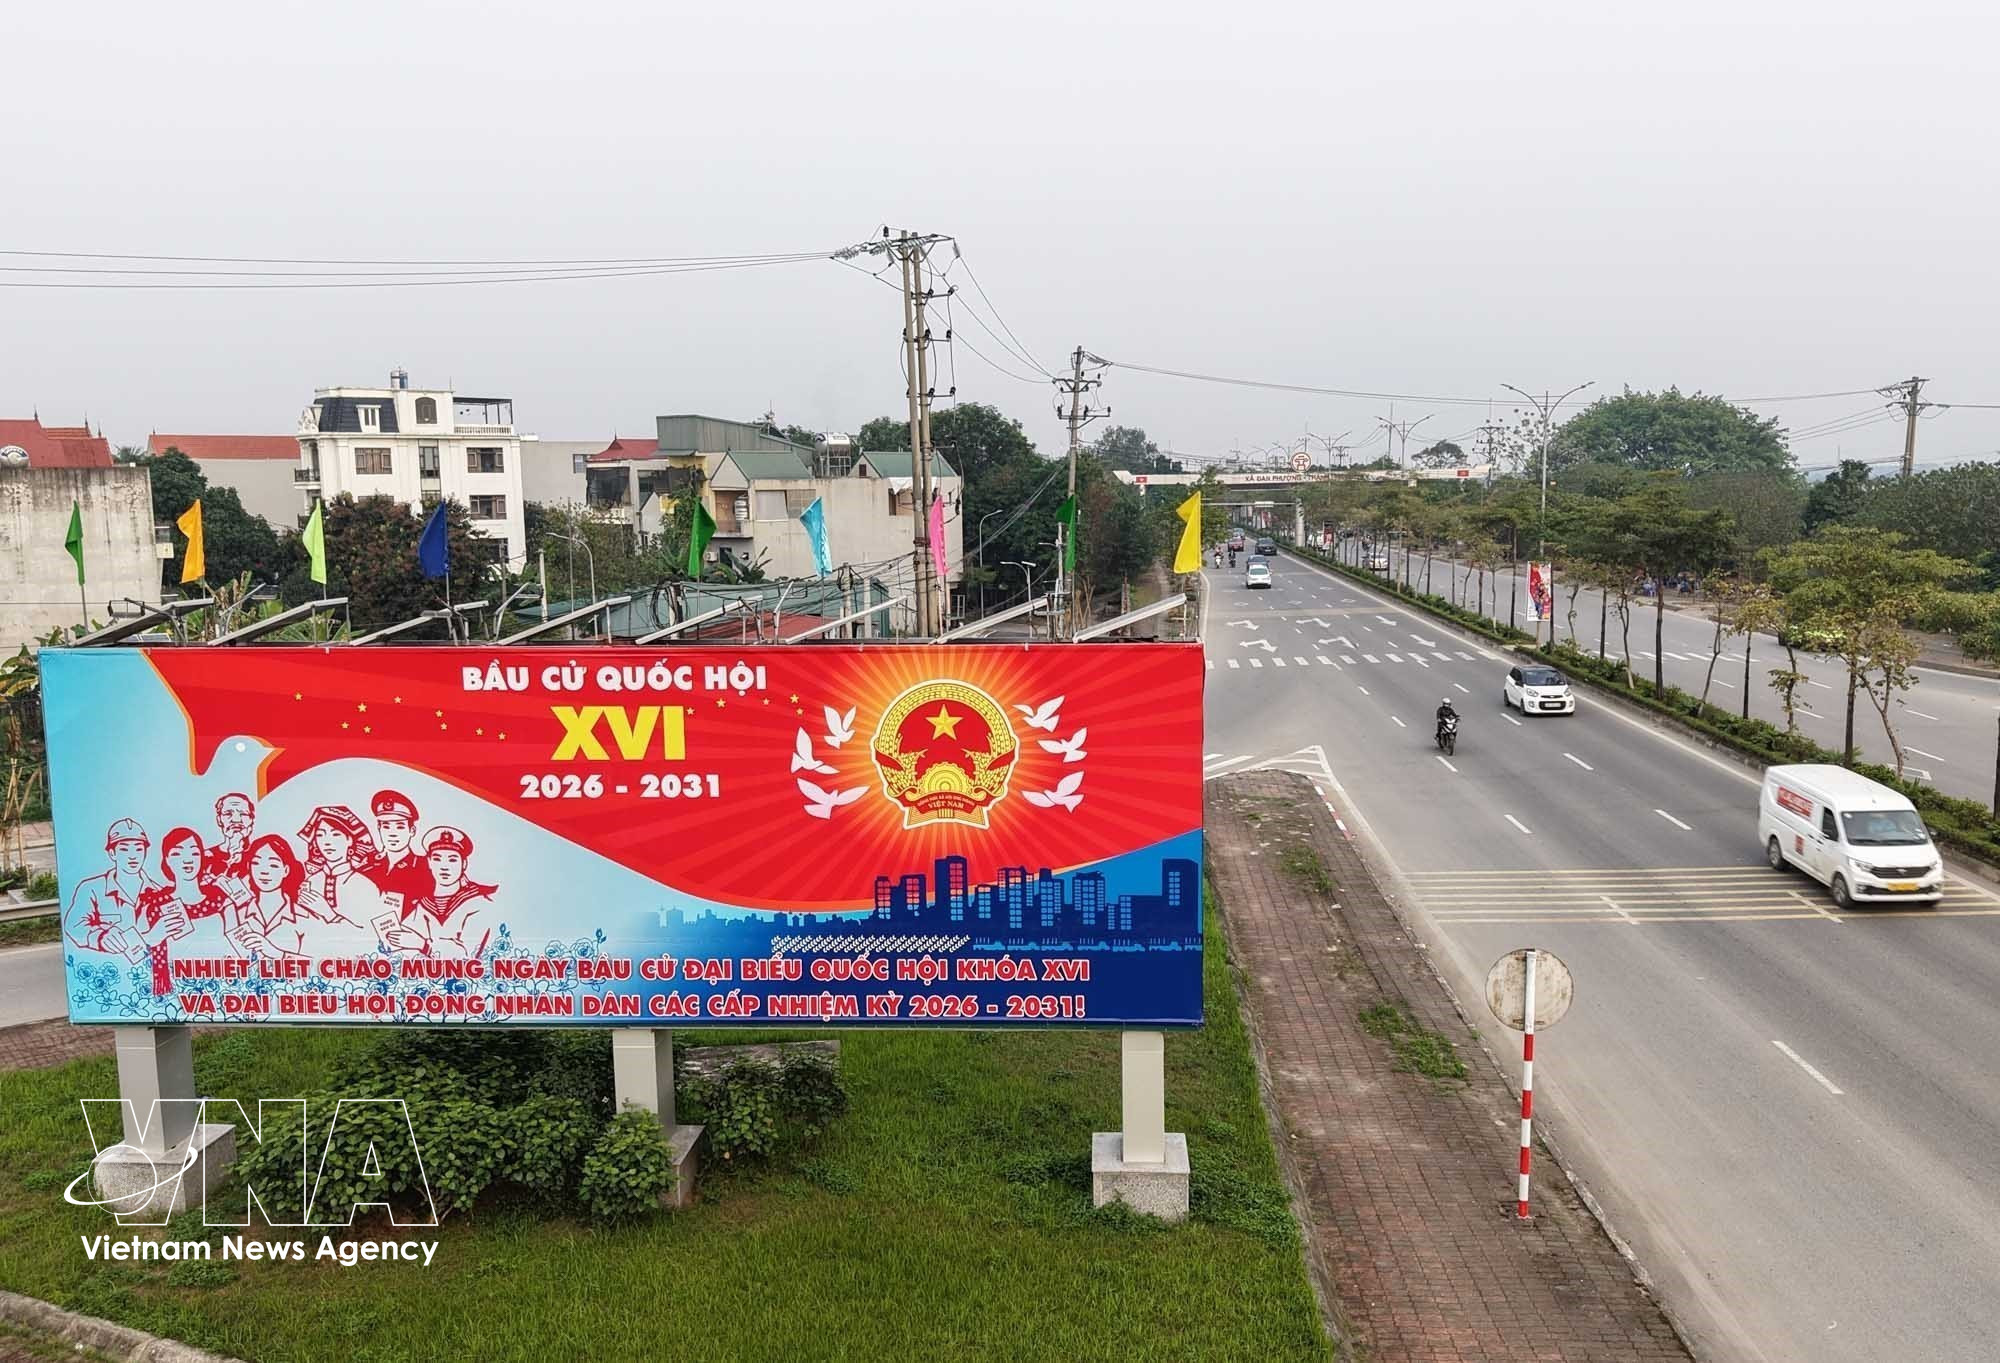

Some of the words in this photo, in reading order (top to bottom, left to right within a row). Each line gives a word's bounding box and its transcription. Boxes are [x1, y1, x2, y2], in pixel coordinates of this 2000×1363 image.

[462, 658, 530, 691] BẦU
[541, 659, 588, 691] CỬ
[596, 658, 693, 692] QUỐC
[704, 660, 767, 696] HỘI
[550, 706, 686, 760] XVI
[520, 774, 604, 798] 2026
[615, 783, 628, 794] -
[640, 774, 720, 798] 2031
[173, 955, 250, 983] NHIỆT
[259, 955, 312, 983] LIỆT
[493, 954, 571, 980] NGÀY
[577, 952, 632, 980] BẦU
[640, 952, 677, 980] CỬ
[684, 957, 732, 985] ĐẠI
[741, 952, 802, 981] BIỂU
[811, 952, 889, 981] QUỐC
[897, 954, 948, 985] HỘI
[957, 954, 1037, 981] KHÓA
[1042, 958, 1090, 981] XVI
[179, 990, 217, 1015] VÀ
[224, 992, 272, 1020] ĐẠI
[279, 987, 338, 1015] BIỂU
[348, 990, 397, 1019] HỘI
[493, 990, 575, 1016] NHÂN
[582, 990, 640, 1016] DÂN
[648, 990, 699, 1016] CÁC
[707, 989, 760, 1017] CẤP
[768, 991, 859, 1021] NHIỆM
[867, 990, 903, 1017] KỲ
[909, 995, 978, 1017] 2026
[1006, 995, 1086, 1017] 2031!
